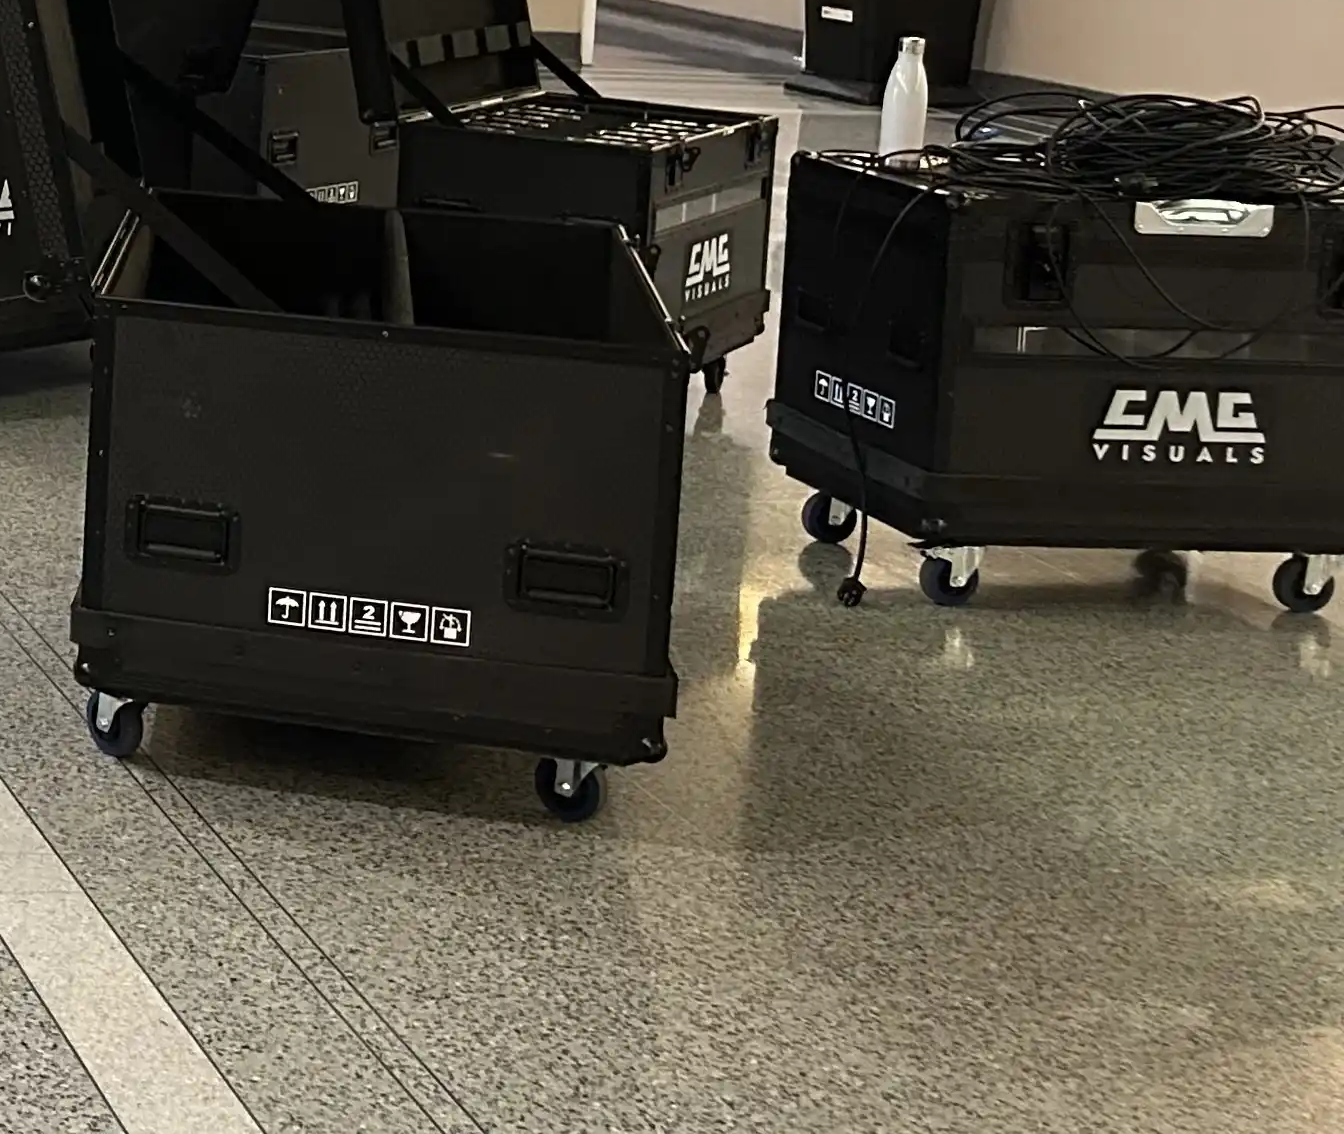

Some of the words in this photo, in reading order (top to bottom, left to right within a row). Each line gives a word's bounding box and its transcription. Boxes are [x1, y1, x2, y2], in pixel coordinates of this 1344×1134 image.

[685, 233, 731, 288] CMG
[1092, 389, 1267, 444] CMG
[1092, 442, 1266, 465] VISUALS
[362, 604, 376, 621] 2
